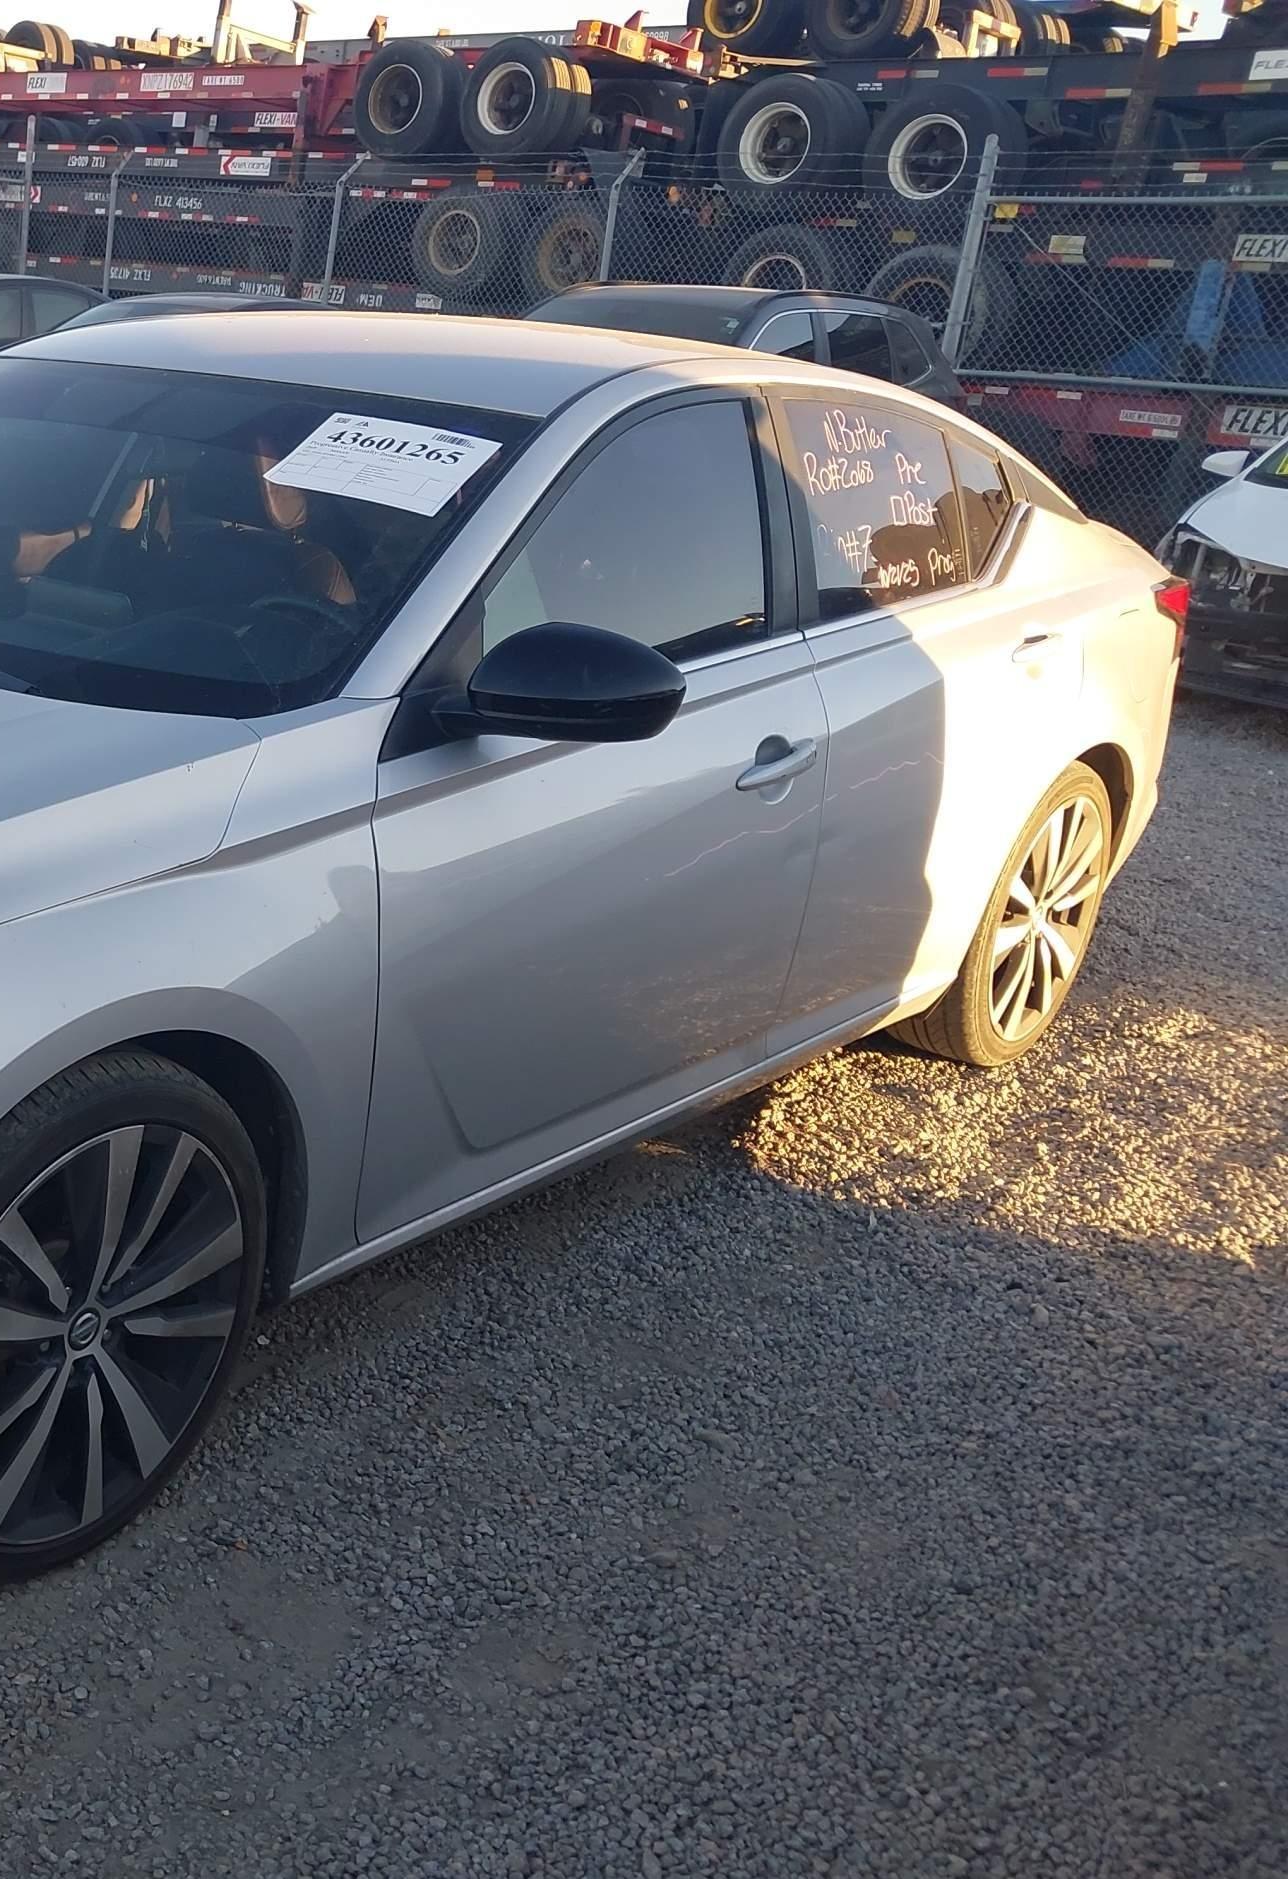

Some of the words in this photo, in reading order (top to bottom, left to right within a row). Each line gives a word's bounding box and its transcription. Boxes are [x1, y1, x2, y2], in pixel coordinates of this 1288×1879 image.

[1254, 59, 1288, 71] FLE
[239, 281, 286, 297] TRUCKING
[327, 430, 465, 466] 43601265
